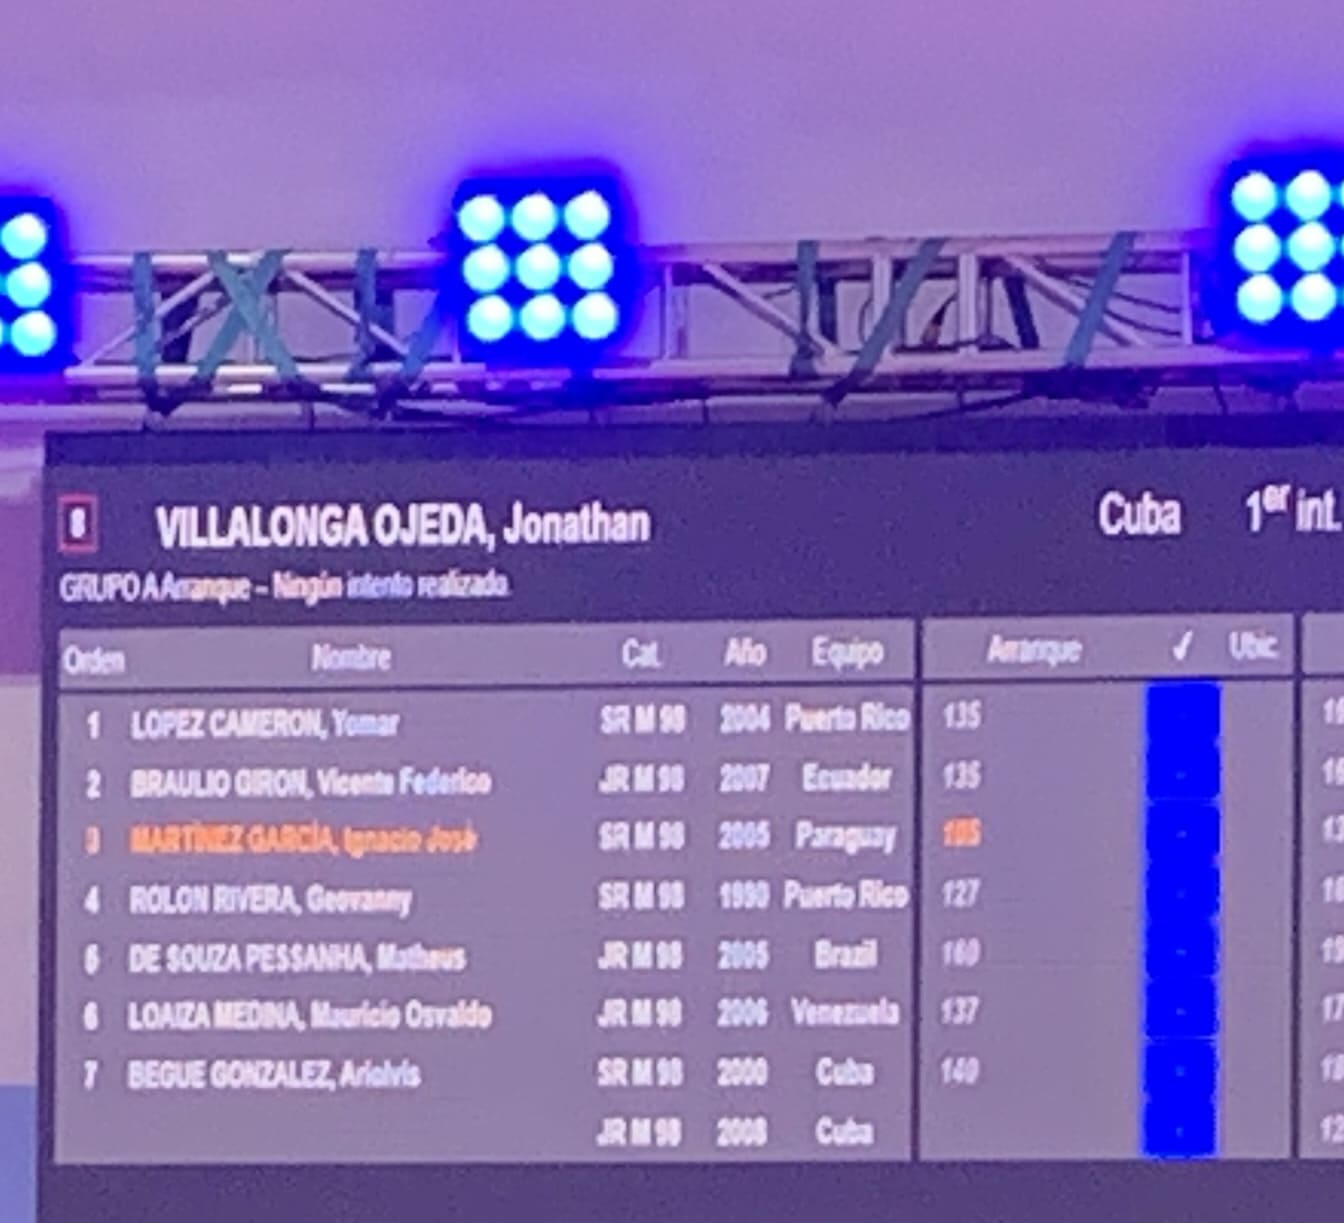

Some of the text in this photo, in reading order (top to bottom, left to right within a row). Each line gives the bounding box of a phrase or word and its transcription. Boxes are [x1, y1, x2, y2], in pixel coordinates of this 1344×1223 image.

[70, 507, 86, 539] 8
[156, 501, 651, 553] VILLALONGA OJEDA, Jonathan
[1099, 490, 1182, 535] Cuba
[1296, 488, 1343, 532] int.
[59, 572, 141, 602] GRUPO
[273, 570, 343, 607] Ningún
[346, 570, 415, 599] intento
[63, 645, 125, 674] Orden
[311, 644, 392, 671] Nombre
[723, 637, 767, 667] Año
[812, 637, 885, 671] Equipo
[987, 634, 1083, 667] Arranque
[87, 711, 101, 739] 1
[130, 709, 204, 739] LOPEZ
[209, 709, 328, 740] CAMERON,
[332, 709, 401, 737] Yomar
[600, 704, 630, 733] SR
[633, 703, 656, 733] M
[720, 704, 771, 733] 2004
[785, 702, 856, 732] Puerto
[860, 702, 911, 731] Rico
[943, 700, 981, 729] 135
[87, 771, 100, 799] 2
[130, 769, 230, 798] BRAULIO
[235, 769, 313, 800] GIRON,
[317, 769, 393, 796] Vicente
[399, 767, 492, 796] Federico
[599, 764, 630, 793] JR
[634, 764, 655, 793] M
[720, 763, 771, 793] 2007
[802, 763, 893, 792] Ecuador
[943, 761, 981, 789] 135
[599, 822, 630, 851] SR
[634, 822, 655, 851] M
[718, 821, 771, 851] 2005
[796, 821, 898, 854] Paraguay
[84, 886, 99, 913] 4
[129, 885, 208, 913] ROLON
[213, 885, 303, 915] RIVERA,
[307, 885, 413, 918] Geovanny
[598, 883, 629, 910] SR
[633, 883, 655, 910] M
[784, 881, 856, 910] Puerto
[859, 881, 910, 909] Rico
[942, 878, 981, 908] 127
[84, 945, 99, 974] 5
[129, 944, 163, 973] DE
[166, 944, 241, 973] SOUZA
[246, 944, 372, 976] PESSANHA,
[377, 943, 467, 971] Matheus
[597, 940, 628, 969] JR
[632, 940, 654, 969] M
[814, 938, 879, 968] Brazil
[128, 1002, 210, 1031] LOAIZA
[214, 1002, 306, 1033] MEDINA,
[311, 1000, 401, 1030] Mauricio
[404, 1000, 492, 1029] Osvaldo
[597, 997, 628, 1026] JR
[632, 997, 654, 1026] M
[790, 996, 900, 1025] Venezuela
[941, 996, 980, 1025] 137
[84, 1060, 98, 1088] 7
[128, 1060, 206, 1088] BEGUE
[210, 1060, 337, 1091] GONZALEZ,
[597, 1057, 628, 1086] SR
[632, 1057, 653, 1086] M
[815, 1057, 875, 1086] Cuba
[596, 1118, 628, 1146] JR
[631, 1118, 652, 1146] M
[815, 1117, 875, 1146] Cuba
